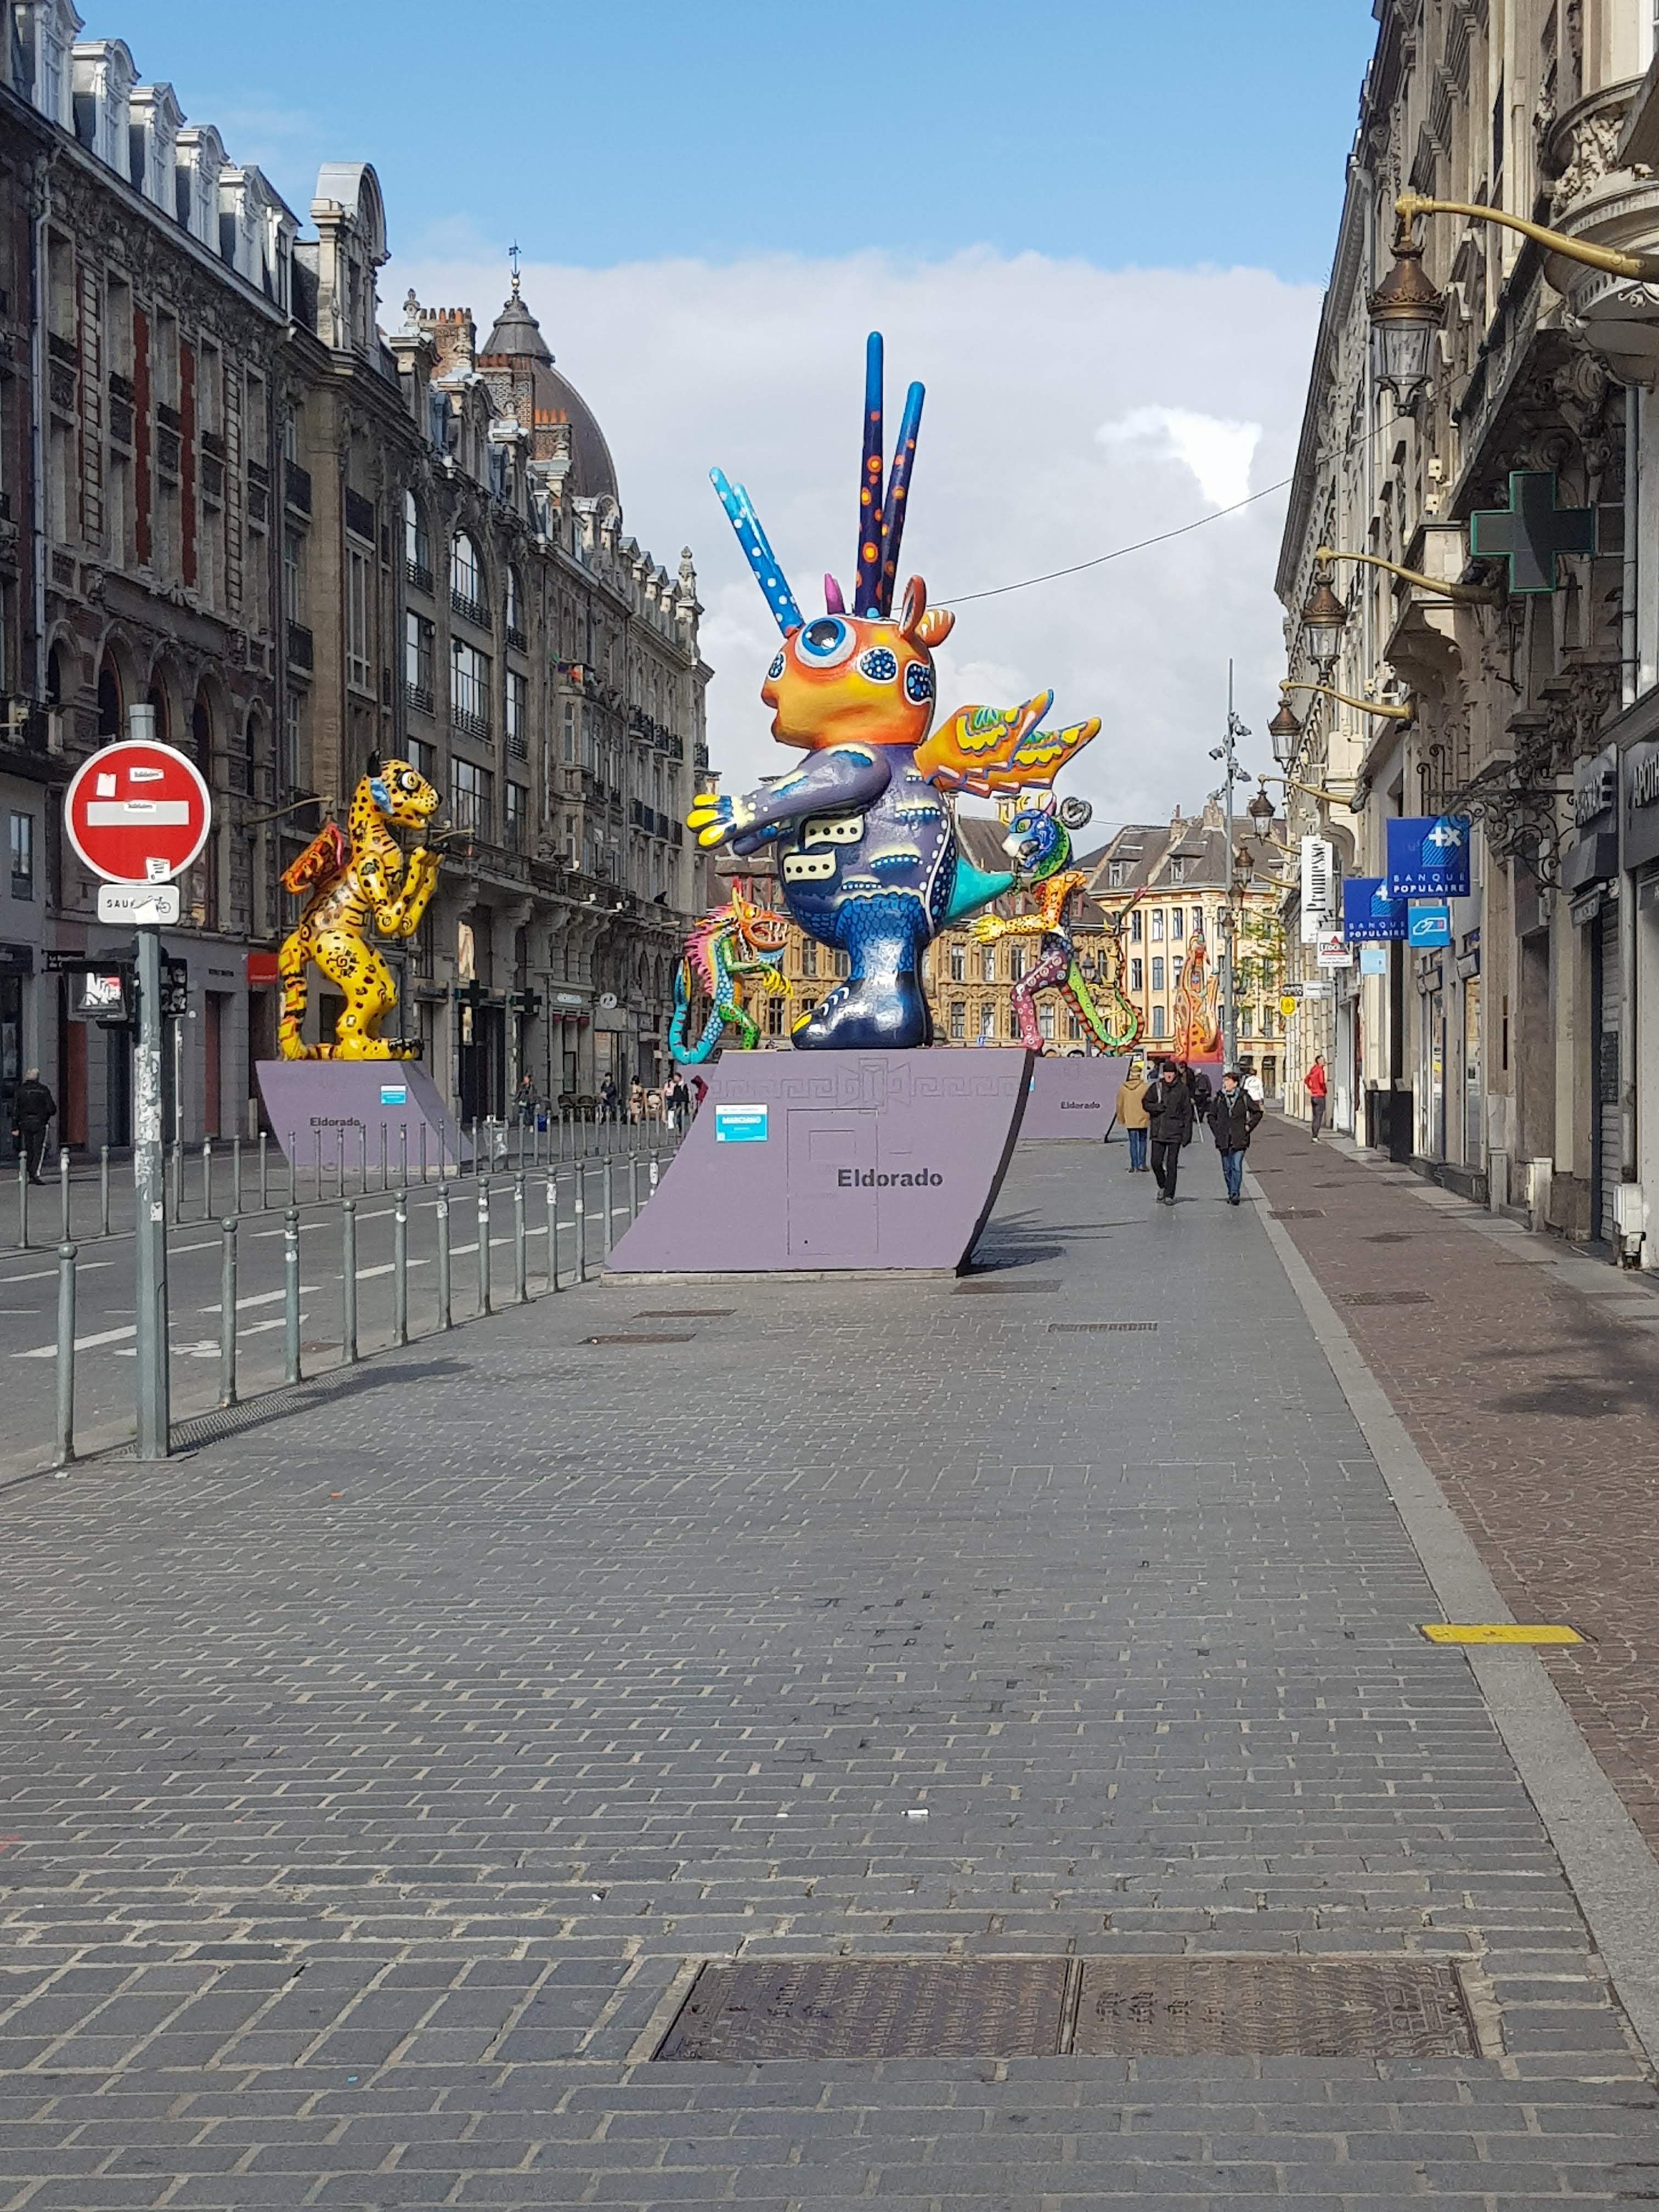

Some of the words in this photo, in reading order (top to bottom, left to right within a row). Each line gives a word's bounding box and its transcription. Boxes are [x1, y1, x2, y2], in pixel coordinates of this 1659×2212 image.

[1306, 843, 1326, 912] Promesse
[1393, 873, 1464, 883] BANQUE
[1393, 884, 1464, 893] POPULAIRE
[1349, 929, 1405, 938] POPULAIRE
[309, 1117, 360, 1126] Eldorado
[838, 1167, 944, 1187] Eldorado
